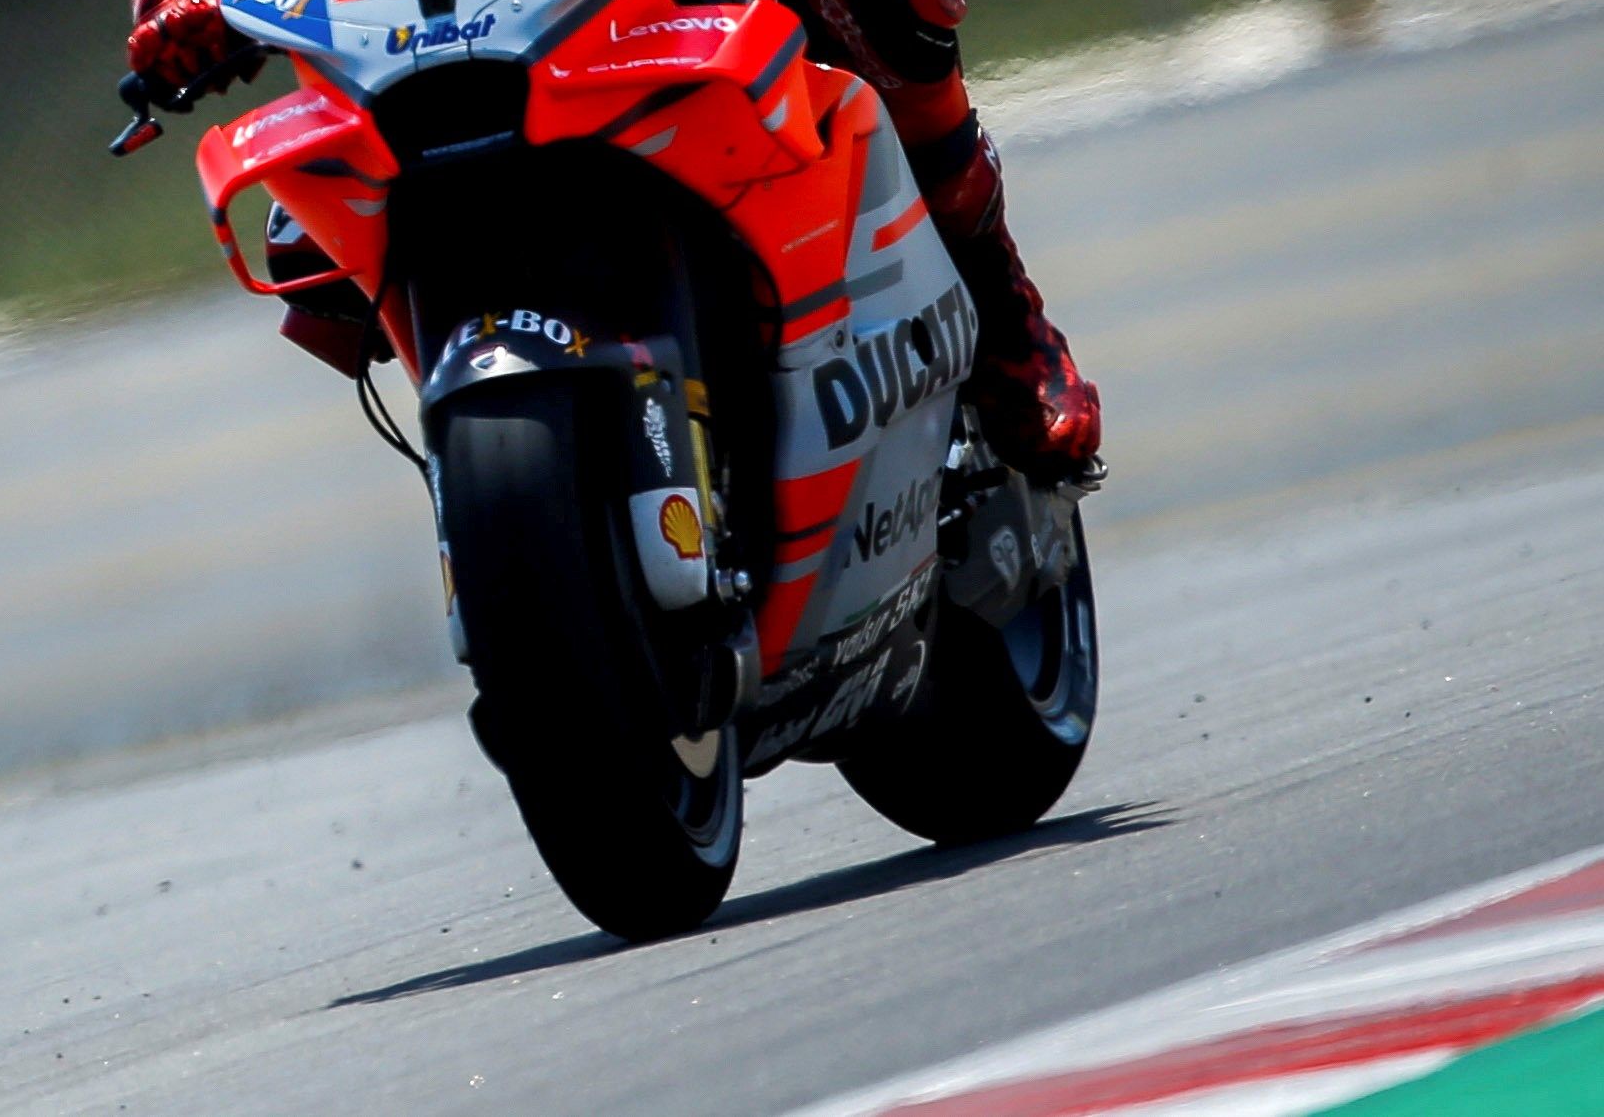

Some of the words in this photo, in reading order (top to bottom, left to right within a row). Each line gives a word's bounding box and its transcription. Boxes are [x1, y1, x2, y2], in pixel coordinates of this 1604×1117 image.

[386, 14, 497, 55] Unibat
[610, 17, 738, 42] Lenovo
[812, 282, 974, 451] DUCATI
